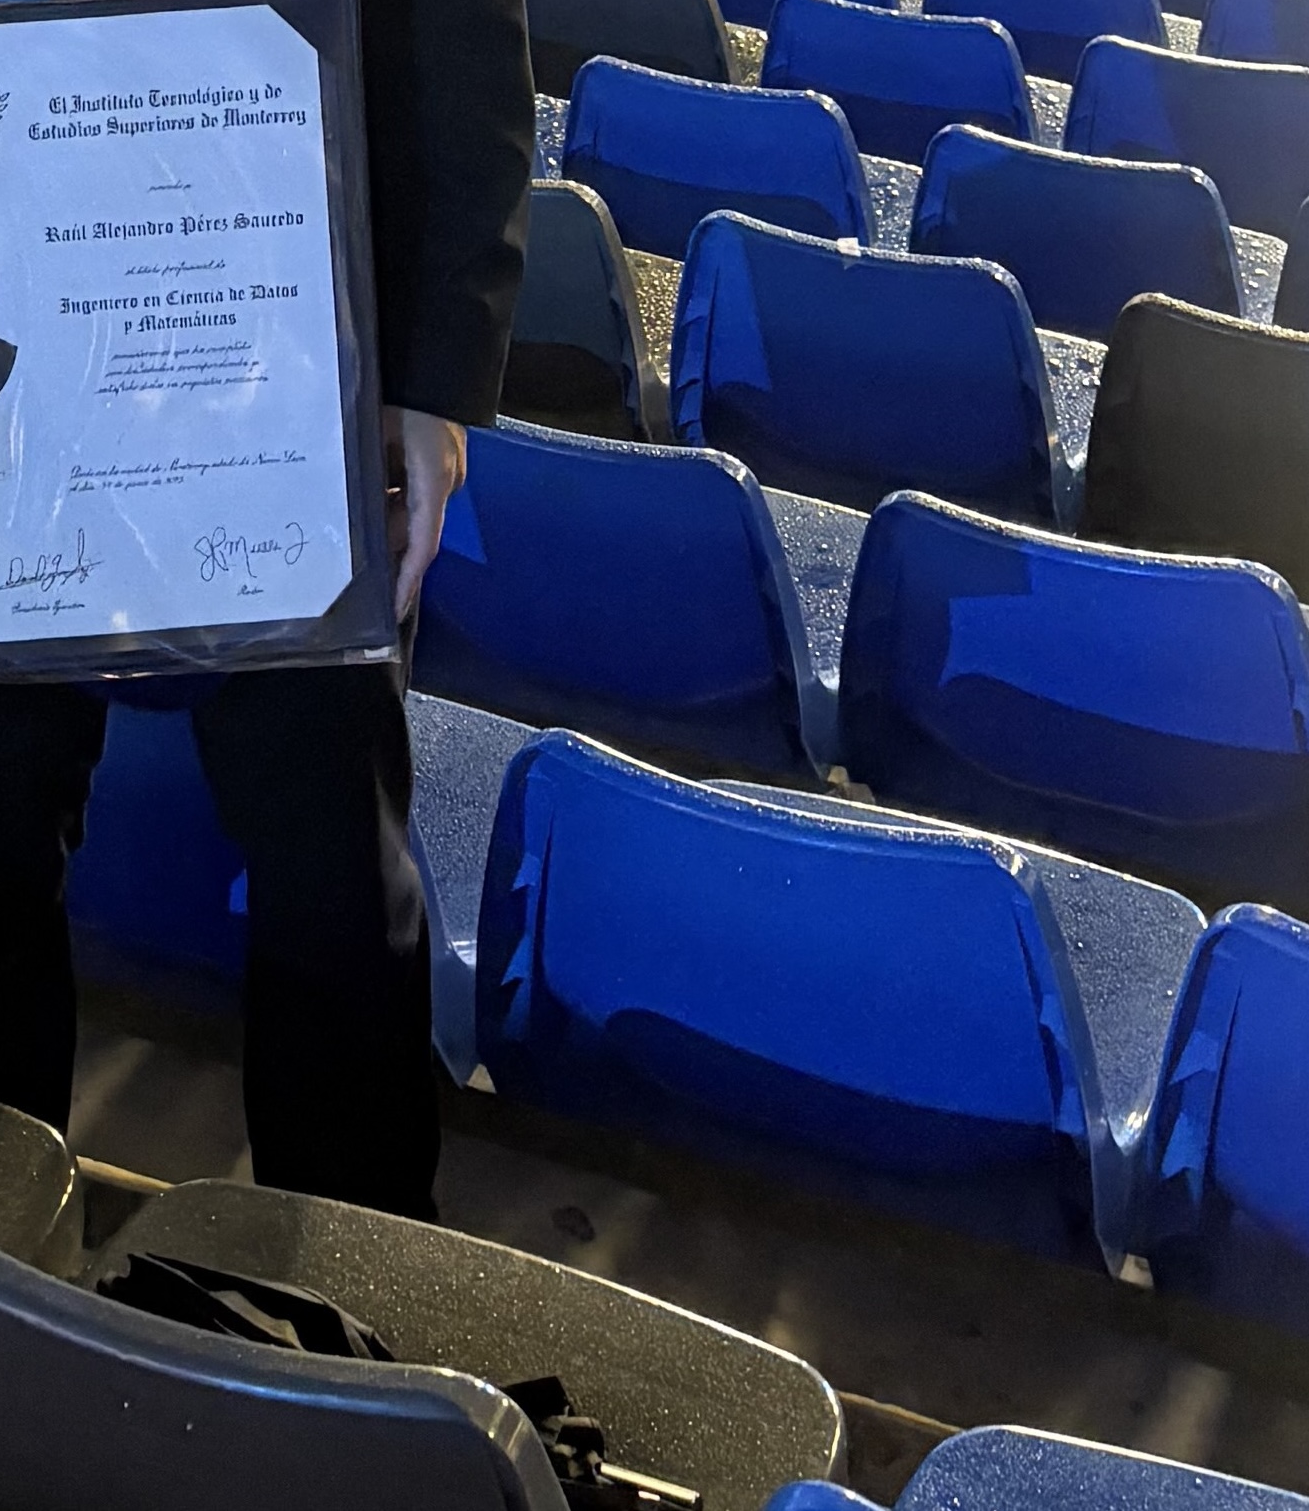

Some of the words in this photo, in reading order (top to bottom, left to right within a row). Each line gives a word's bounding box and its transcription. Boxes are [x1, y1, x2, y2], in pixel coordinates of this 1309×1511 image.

[49, 95, 66, 115] El
[69, 93, 143, 117] Instituto
[148, 86, 243, 109] Tecnológico
[249, 89, 260, 105] y
[264, 83, 282, 99] de
[28, 120, 102, 141] Estudios
[106, 115, 195, 138] Superiores
[201, 112, 219, 128] de
[222, 107, 306, 131] Monterrey
[45, 223, 87, 243] Raúl
[92, 221, 174, 241] Alejandro
[180, 214, 228, 236] Pérez
[233, 211, 304, 230] Saucedo
[59, 296, 138, 316] Ingeniero
[143, 295, 161, 308] en
[166, 289, 224, 306] Ciencia
[229, 286, 245, 301] de
[249, 283, 299, 300] Datos
[137, 309, 237, 333] Matemáticas
